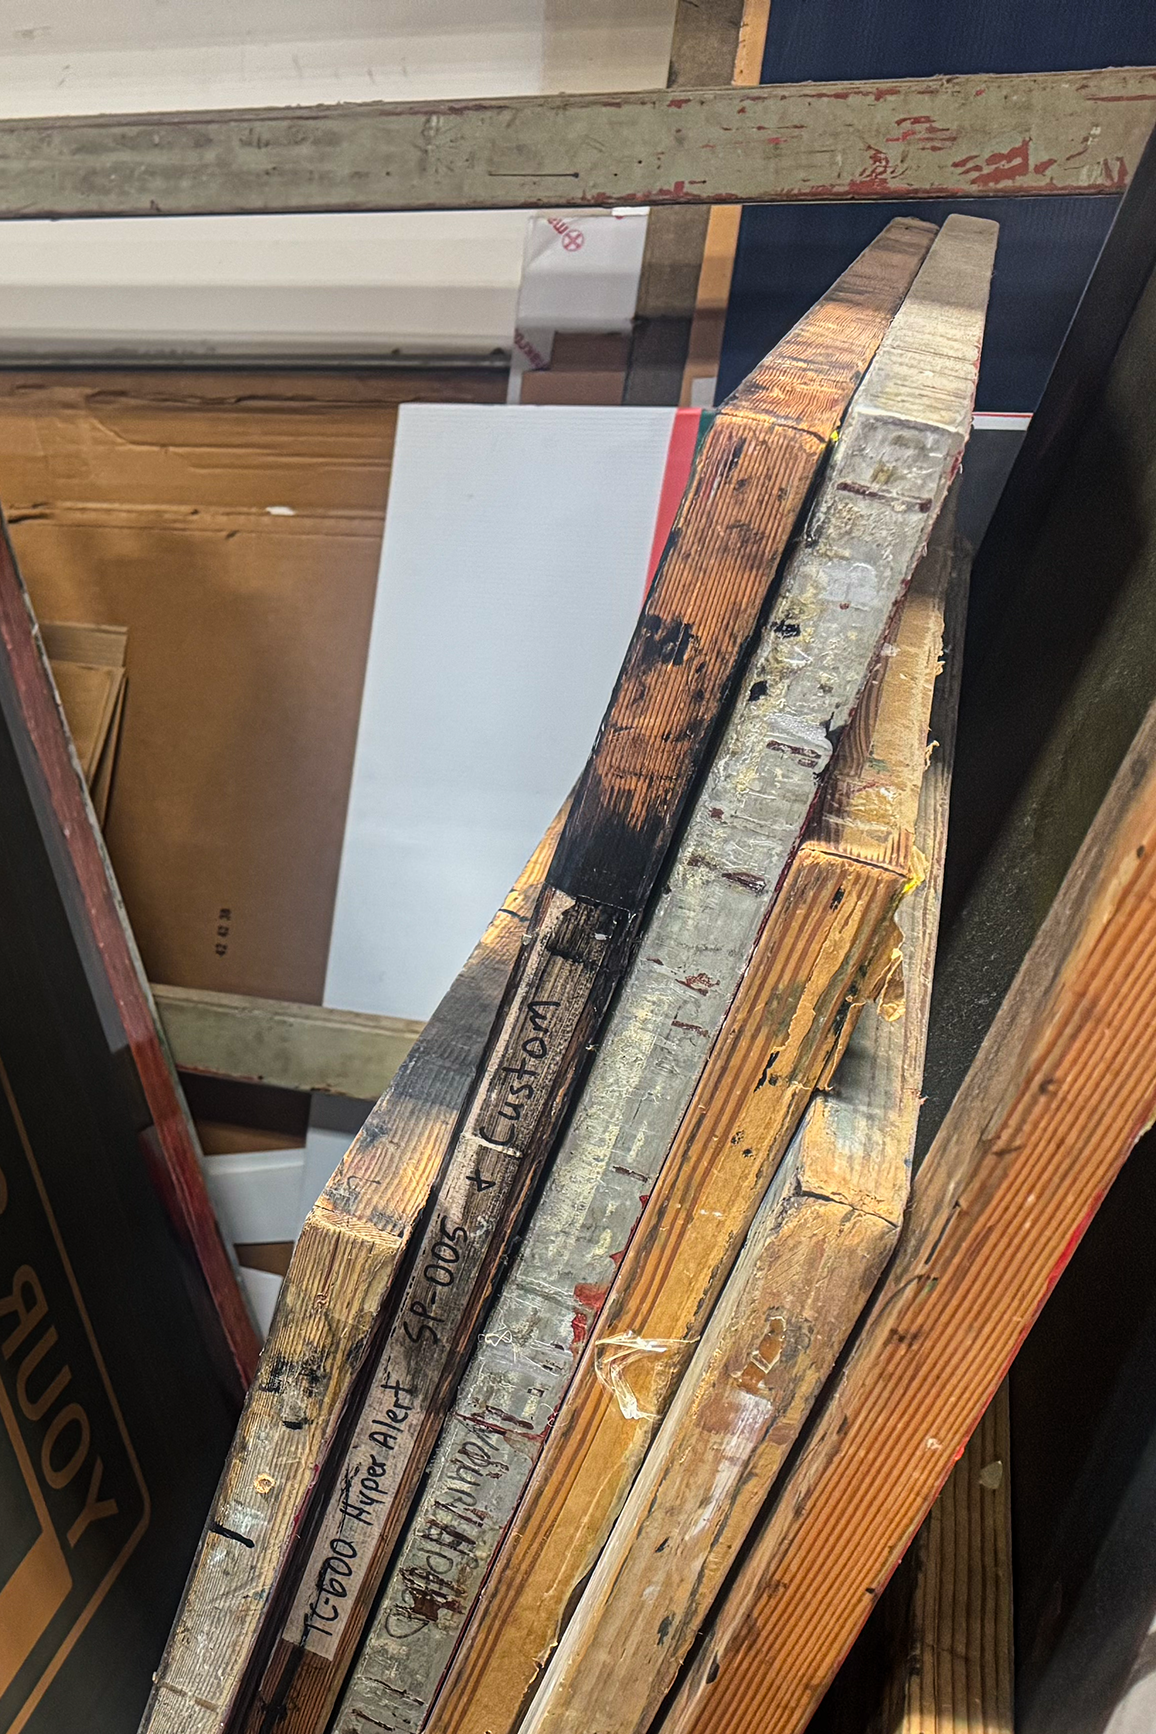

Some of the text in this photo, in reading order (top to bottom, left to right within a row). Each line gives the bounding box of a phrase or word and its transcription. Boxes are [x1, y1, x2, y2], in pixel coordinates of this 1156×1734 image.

[342, 1454, 388, 1526] Hyper
[368, 1380, 416, 1450] Alert
[403, 1217, 468, 1345] SP-005
[480, 1001, 561, 1146] Custom
